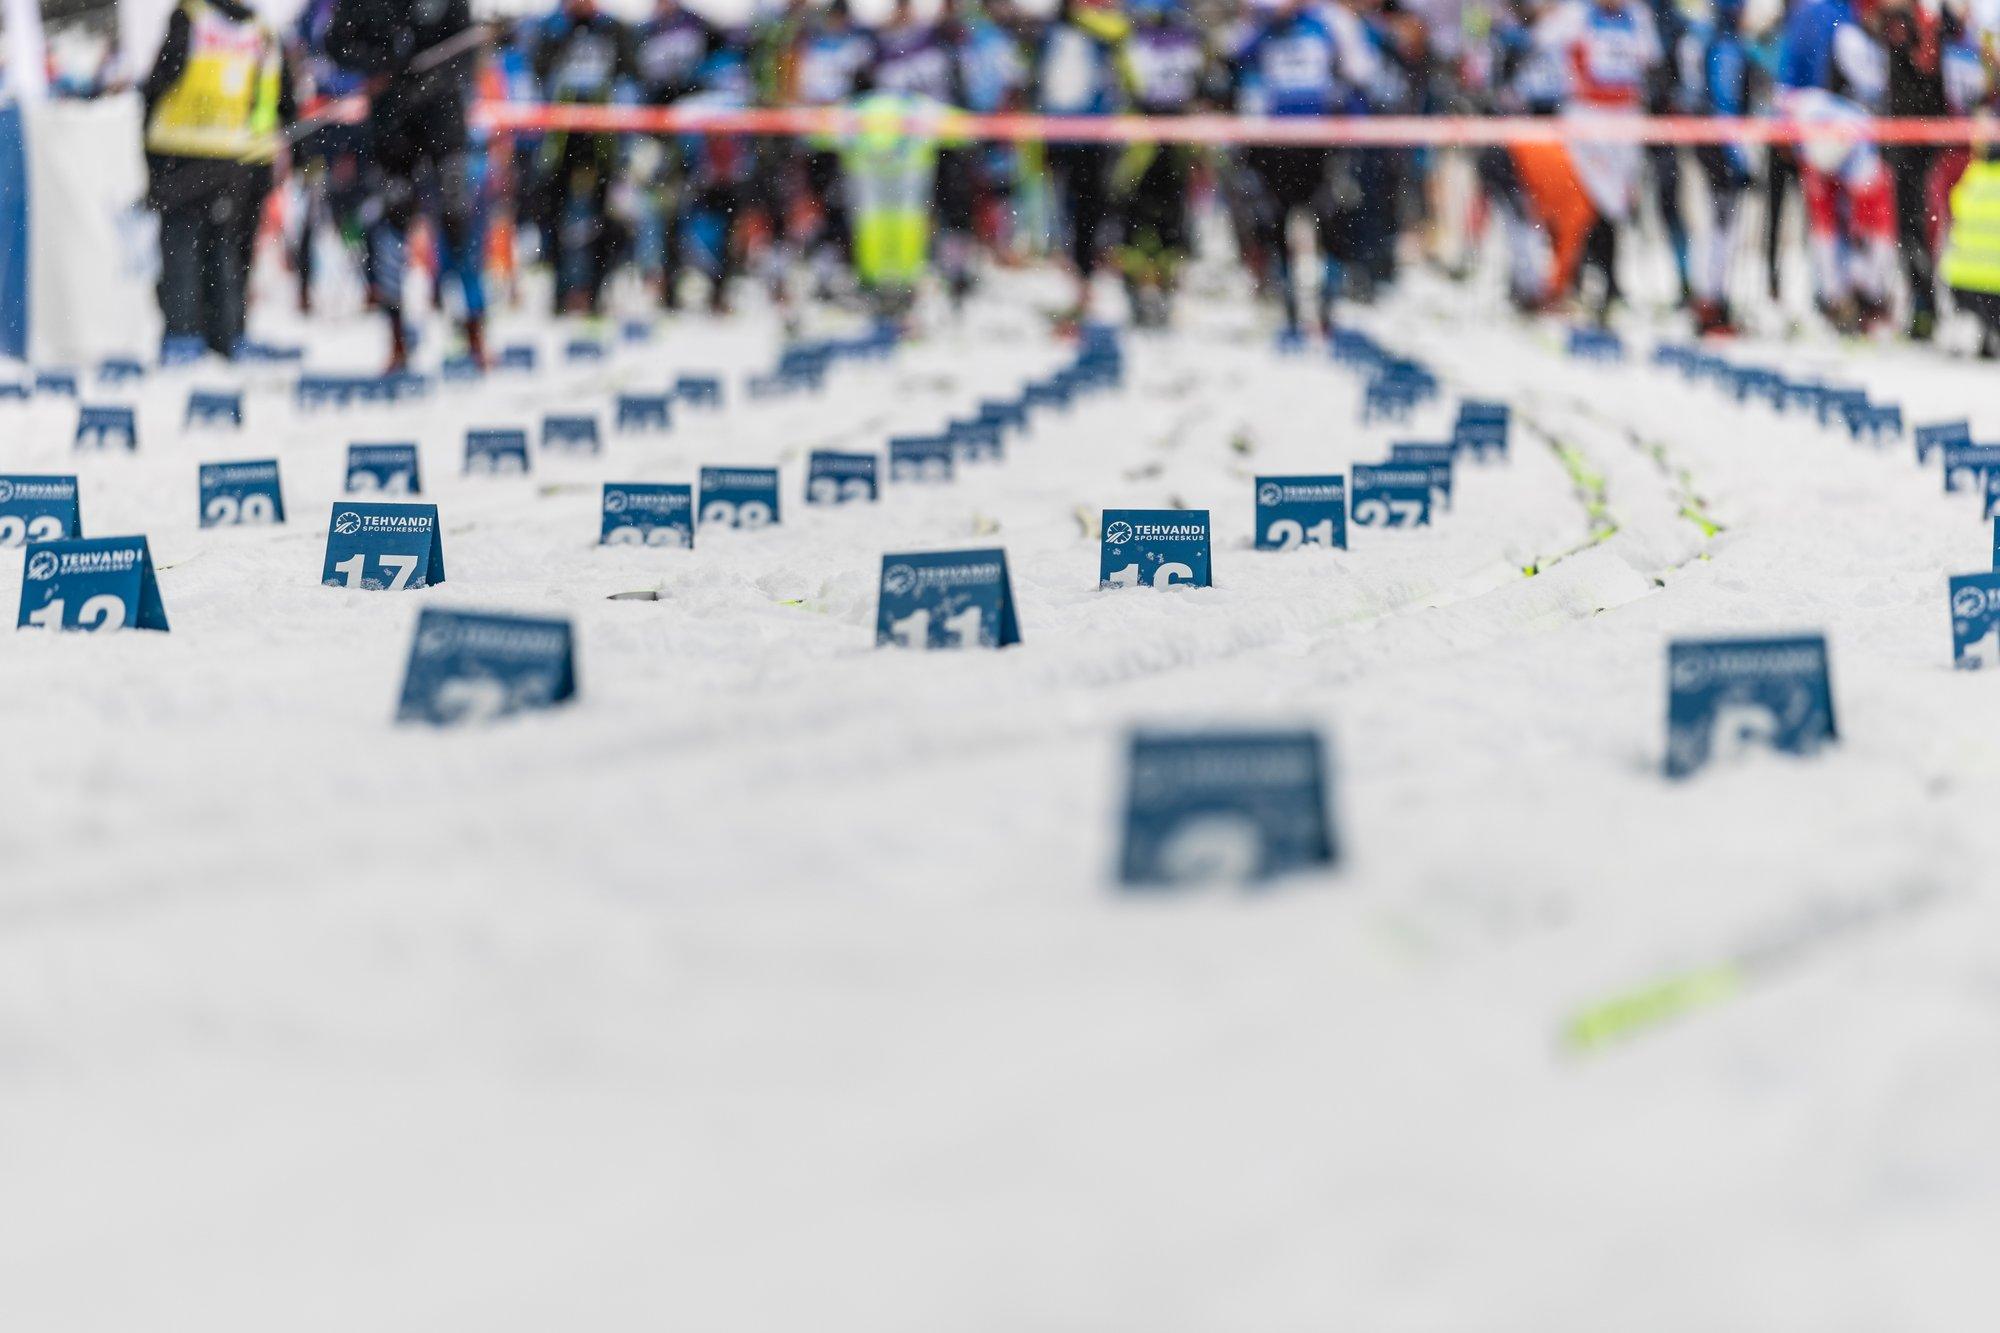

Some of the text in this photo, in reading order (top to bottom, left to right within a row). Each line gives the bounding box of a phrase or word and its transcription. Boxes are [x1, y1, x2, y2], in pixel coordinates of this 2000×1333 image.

[363, 516, 433, 527] TEHVANDI
[1135, 525, 1205, 535] TEHVANDI
[1266, 519, 1334, 550] 21
[61, 549, 143, 567] TEHVANDI
[335, 554, 418, 591] 17
[1109, 562, 1193, 591] 16
[29, 594, 126, 635] 12
[891, 605, 982, 650] 11
